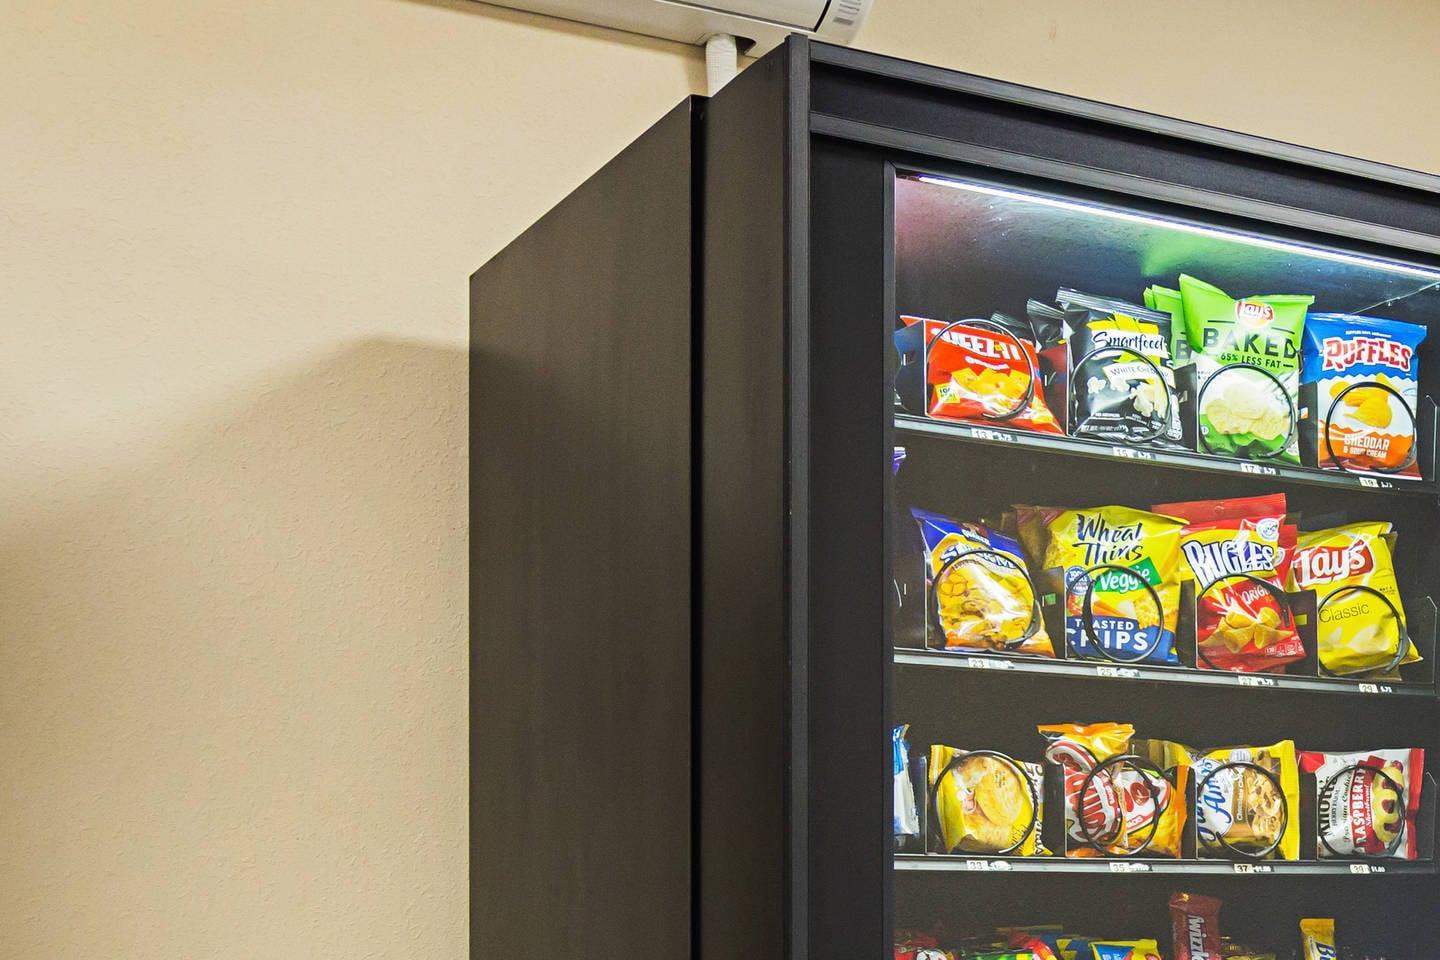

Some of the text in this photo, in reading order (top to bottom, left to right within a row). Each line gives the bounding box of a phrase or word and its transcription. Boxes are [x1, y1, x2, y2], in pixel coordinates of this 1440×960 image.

[1092, 331, 1165, 351] Smartfood
[1203, 327, 1297, 359] BAKED
[1324, 336, 1413, 372] RUFFLES
[1220, 352, 1282, 369] 65% LESS FAT
[1075, 512, 1144, 543] Wheat
[1072, 541, 1145, 566] Thins
[1180, 539, 1275, 589] BUGLES
[1292, 538, 1368, 588] Lay's
[1099, 564, 1151, 595] Veggie
[1318, 602, 1371, 624] Classic
[972, 659, 985, 668] 23
[1351, 769, 1367, 844] RASPBERRY
[1236, 864, 1248, 873] 37
